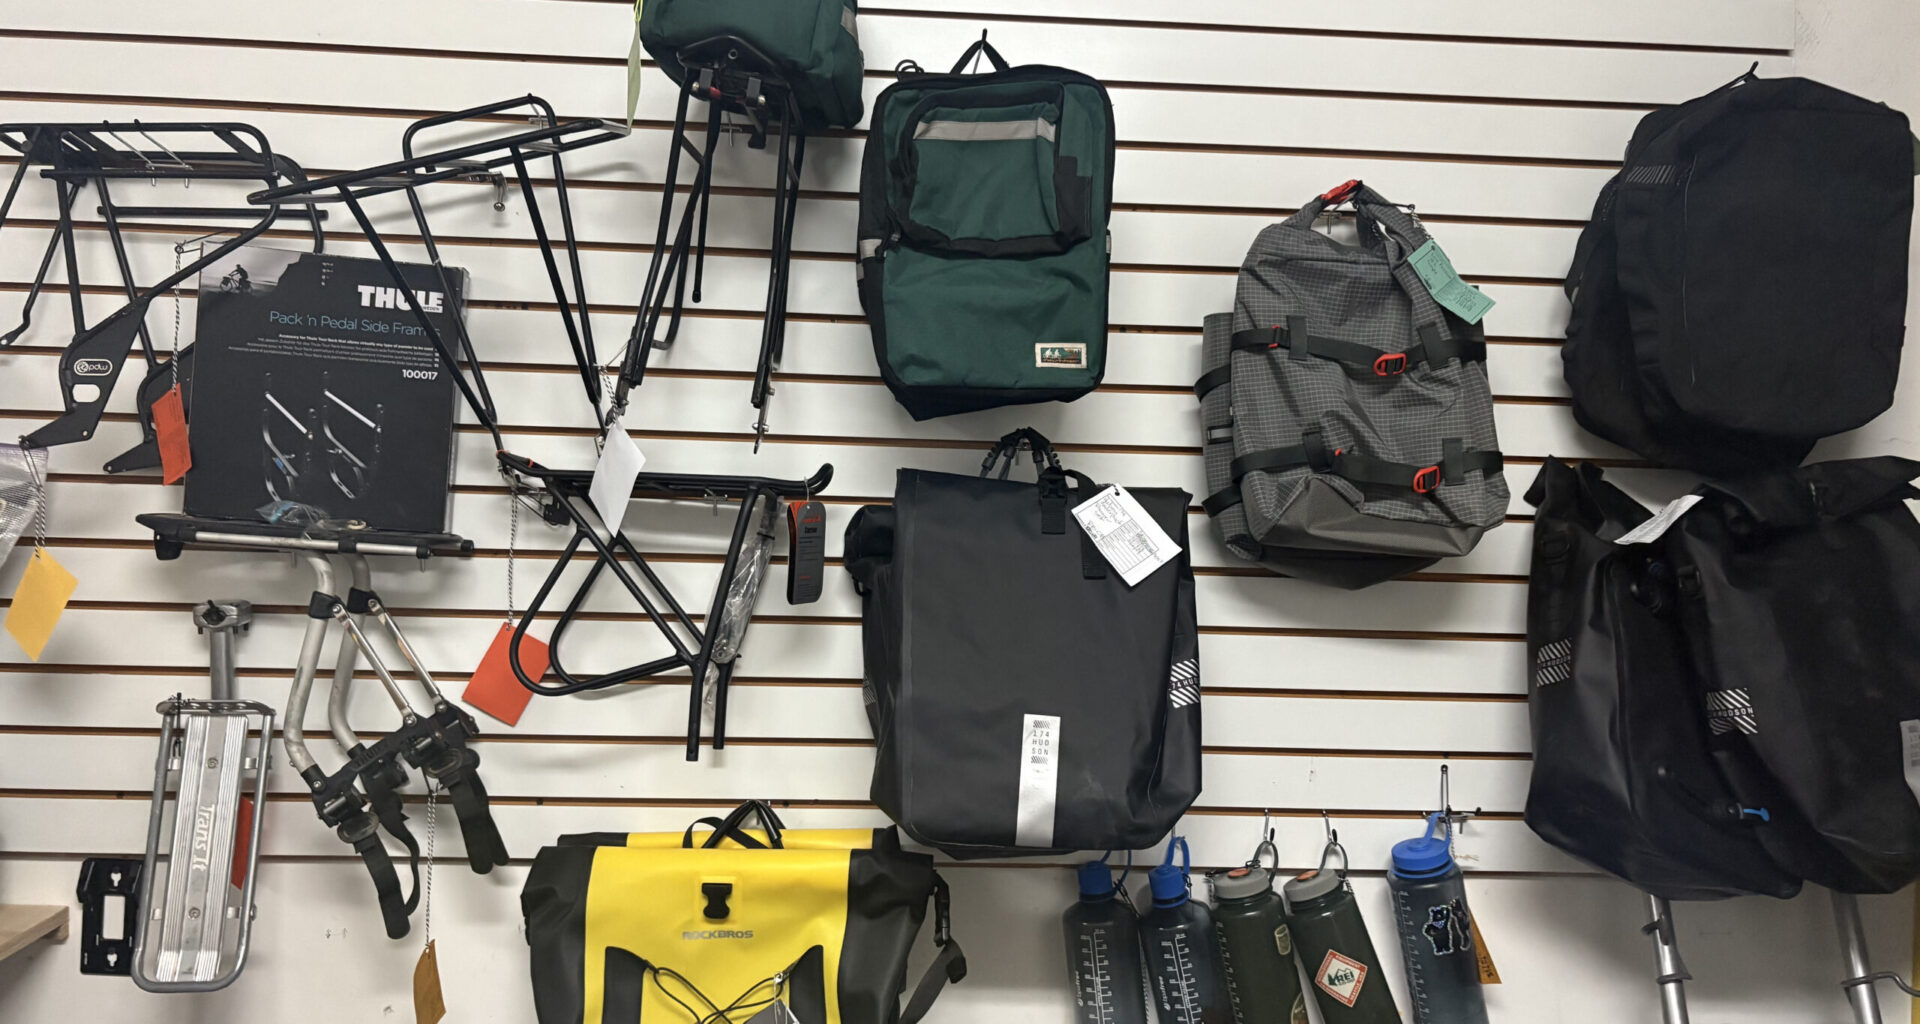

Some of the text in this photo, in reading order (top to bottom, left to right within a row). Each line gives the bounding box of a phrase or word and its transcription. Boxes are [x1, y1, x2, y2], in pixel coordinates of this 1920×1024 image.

[357, 284, 444, 312] THULE
[269, 310, 303, 325] Pack
[321, 315, 358, 330] Pedal
[361, 319, 390, 333] Side
[392, 321, 441, 337] Frams
[402, 369, 438, 380] 100017
[194, 803, 215, 852] Trans
[682, 930, 754, 940] ROCKBROS
[1335, 971, 1355, 983] REI
